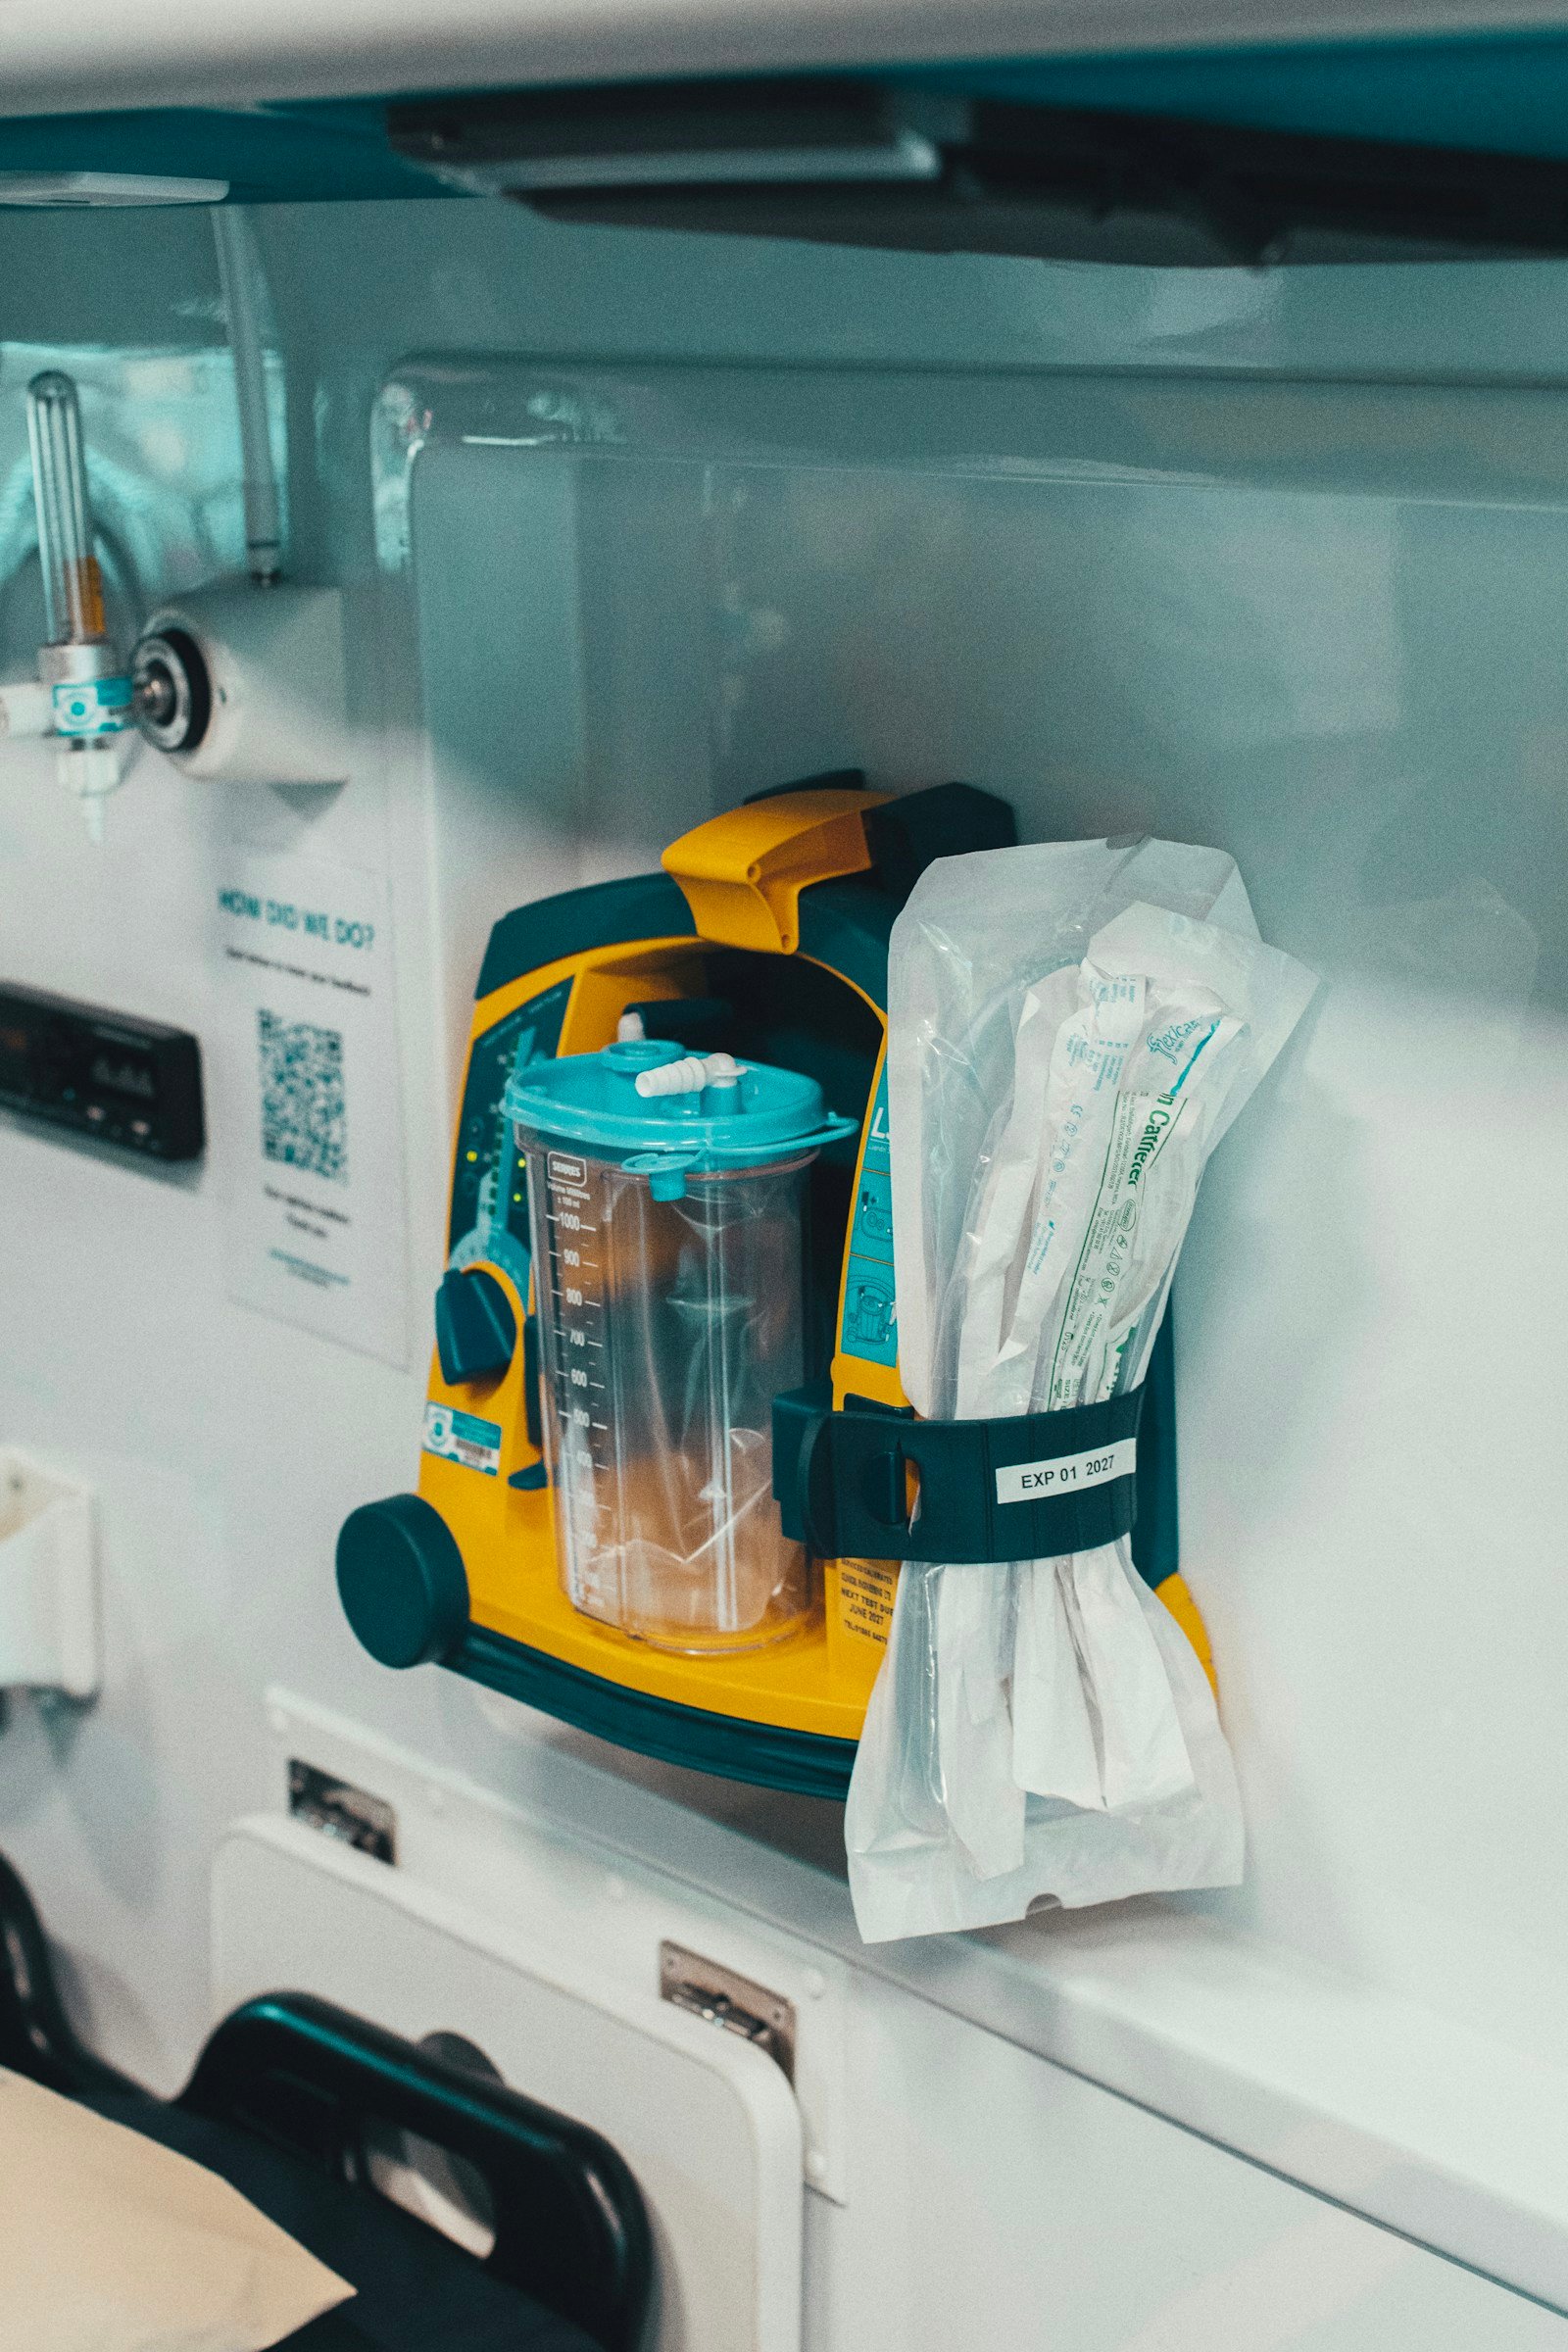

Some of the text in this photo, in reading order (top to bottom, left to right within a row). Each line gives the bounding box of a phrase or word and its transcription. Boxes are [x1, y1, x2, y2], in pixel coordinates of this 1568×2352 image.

[218, 888, 375, 951] HOW DID WE DO?
[560, 1211, 580, 1232] 1000
[564, 1248, 580, 1267] 900
[565, 1287, 583, 1306] 800
[569, 1328, 585, 1348] 700
[570, 1368, 587, 1388] 600
[1021, 1454, 1114, 1489] EXP 01 2027
[860, 1595, 878, 1610] TEST
